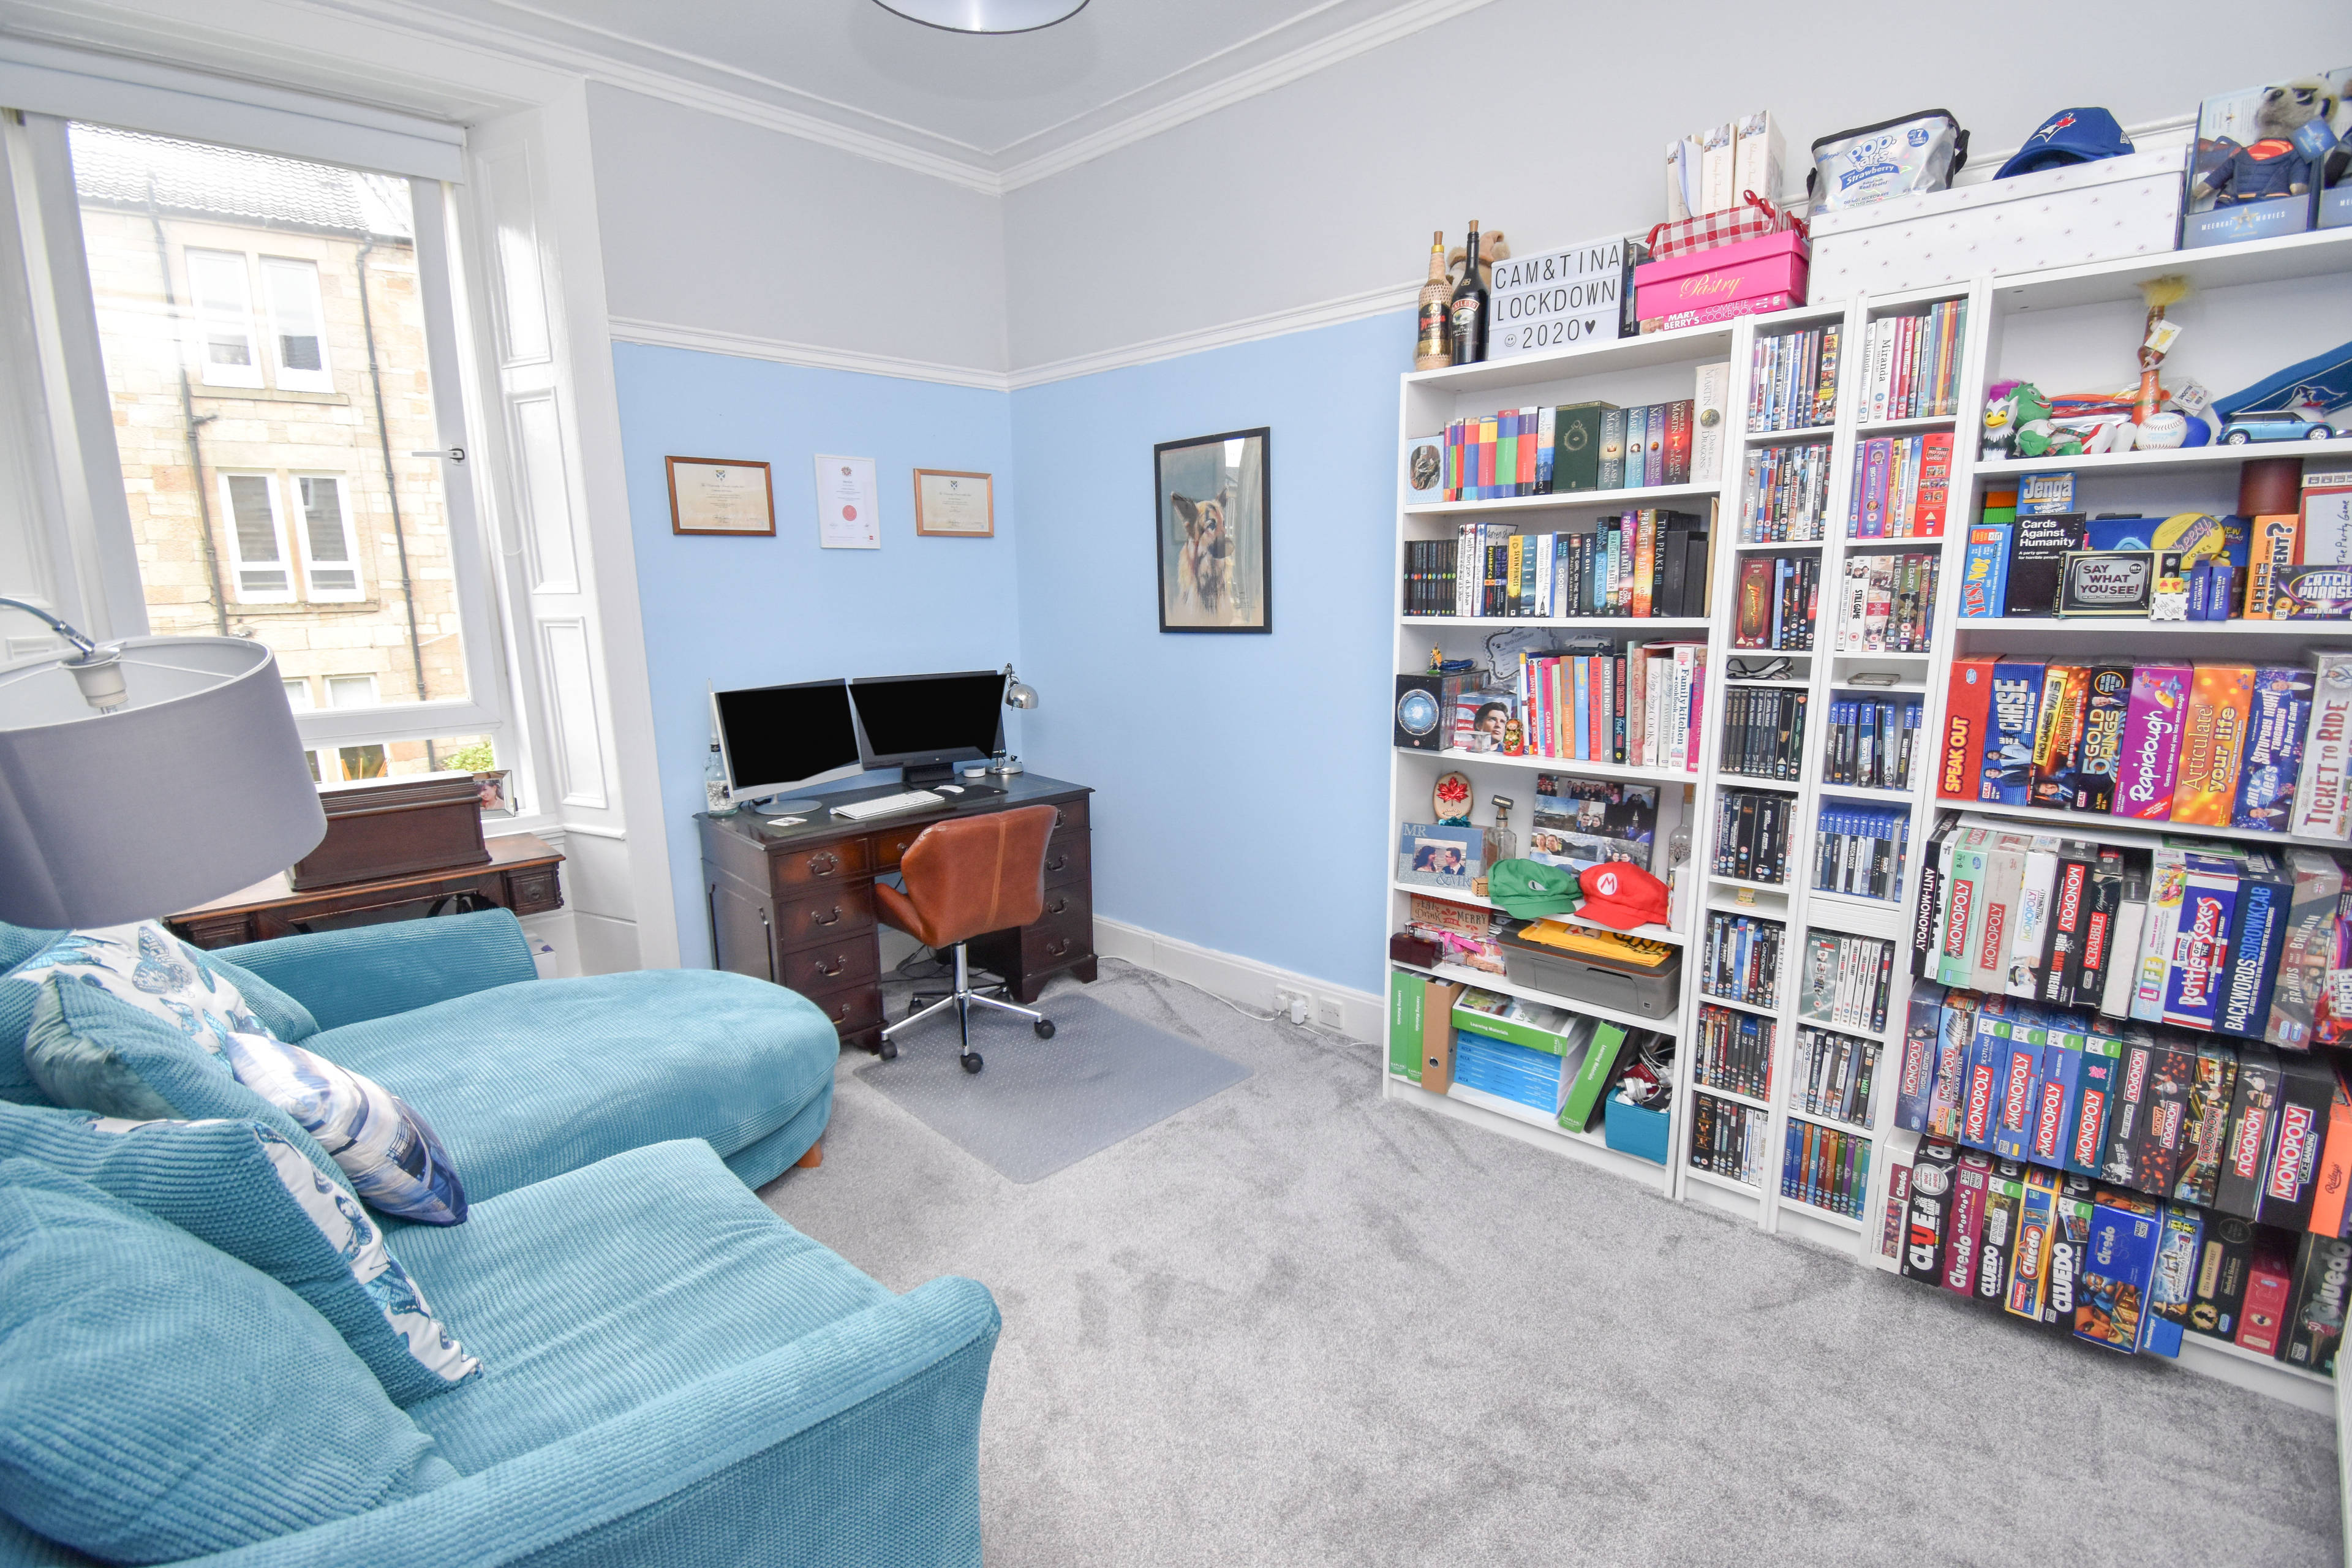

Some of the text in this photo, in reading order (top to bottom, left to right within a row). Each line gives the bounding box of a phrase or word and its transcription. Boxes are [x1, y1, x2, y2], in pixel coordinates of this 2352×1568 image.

[1847, 165, 1893, 185] Strawberry
[2201, 211, 2285, 231] MEERKAT MOVIES
[1495, 245, 1620, 289] CAM&TINA
[1498, 279, 1615, 321] LOCKDOWN
[1679, 272, 1744, 301] Pastry
[1664, 318, 1700, 331] BERRY'S
[1668, 310, 1696, 322] MARY
[1700, 306, 1754, 323] COOKBOOK
[1705, 300, 1749, 314] COMPLETE
[1523, 319, 1579, 349] 2020
[1879, 339, 1891, 382] Miranda
[1703, 369, 1714, 407] MARTIN
[1607, 412, 1616, 445] MARTIN
[1671, 403, 1681, 434] MARTIN
[1700, 431, 1709, 468] DRAGONS
[1781, 461, 1792, 514] TROPIC THUNDER
[2023, 477, 2071, 502] Jenga
[1639, 513, 1649, 549] PRATCHETT
[2021, 529, 2064, 538] Against
[2022, 519, 2057, 529] Cards
[1654, 519, 1666, 571] TIM PEAKE
[2019, 538, 2075, 549] Humanity
[1638, 557, 1646, 581] BAXTER
[1967, 557, 1991, 582] NO!
[2083, 565, 2109, 574] SAY
[2089, 575, 2130, 583] WHAT
[1853, 590, 1863, 619] STILL GAME
[1964, 582, 1985, 617] YES!
[2081, 584, 2139, 595] YOU SEE!
[2214, 576, 2222, 610] MILLIONAIRE
[1615, 658, 1626, 734] GORDON RAMSAY'S fast
[1677, 668, 1689, 745] Family kitchen
[1994, 679, 2027, 731] CHASE
[2064, 698, 2076, 717] GAME
[2037, 681, 2061, 761] WHO DARES WINS
[2059, 718, 2072, 740] BOARD
[2101, 710, 2120, 758] RINGS
[2281, 701, 2298, 756] The Board Game
[1945, 717, 1969, 792] SPEAK OUT
[2057, 741, 2068, 753] THE
[2082, 709, 2111, 775] 5 GOLD
[2130, 710, 2172, 801] Rapidough
[2182, 704, 2213, 791] Articulate!
[2207, 707, 2234, 792] your life
[2259, 766, 2278, 796] dec's
[1403, 824, 1427, 837] MR
[1916, 868, 1936, 950] ANTI-MONOPOLY
[1950, 882, 1970, 951] MONOPOLY
[2022, 892, 2037, 939] MONOPOLY
[2060, 867, 2081, 930] MONOPOLY
[1457, 911, 1487, 925] MERRY
[1985, 905, 2003, 968] MONOPOLY
[2085, 915, 2103, 967] SCRABBLE
[2193, 946, 2199, 954] OF
[2201, 945, 2209, 956] THE
[2046, 938, 2067, 1000] BIG BANG THEORY
[2140, 960, 2162, 997] LIFE
[2178, 957, 2207, 1006] Battle
[1470, 1021, 1509, 1036] Learning Materials
[1588, 1044, 1607, 1080] Learning Materials
[1905, 1042, 1923, 1095] MONOPOLY
[1981, 1036, 1990, 1065] SCOTLAND
[2007, 1055, 2030, 1125] MONOPOLY
[2127, 1050, 2144, 1101] MONOPOLY
[1968, 1067, 1990, 1136] MONOPOLY
[2040, 1084, 2061, 1152] MONOPOLY
[2077, 1091, 2100, 1159] MONOPOLY
[2153, 1107, 2165, 1135] JACKPOT
[2162, 1104, 2177, 1147] MONOPOLY
[2193, 1121, 2201, 1142] EMPIRE
[2199, 1110, 2217, 1162] MONOPOLY
[2237, 1110, 2258, 1176] MONOPOLY
[2275, 1109, 2307, 1197] MONOPOLY
[2298, 1134, 2315, 1183] VOICE BANKING
[1895, 1170, 1907, 1197] Cluedo
[2325, 1162, 2342, 1194] Ridley's
[1909, 1212, 1936, 1271] CLUE
[1990, 1210, 2002, 1243] EDINBURGH
[1997, 1218, 2006, 1238] EDITION
[1949, 1236, 1971, 1288] Cluedo
[2023, 1231, 2040, 1275] Cluedo
[2098, 1226, 2115, 1265] Cluedo
[1981, 1246, 1998, 1297] CLUEDO
[2052, 1243, 2072, 1313] CLUEDO
[2313, 1242, 2348, 1318] Cluedo
[2144, 1318, 2156, 1349] Ravensburger
